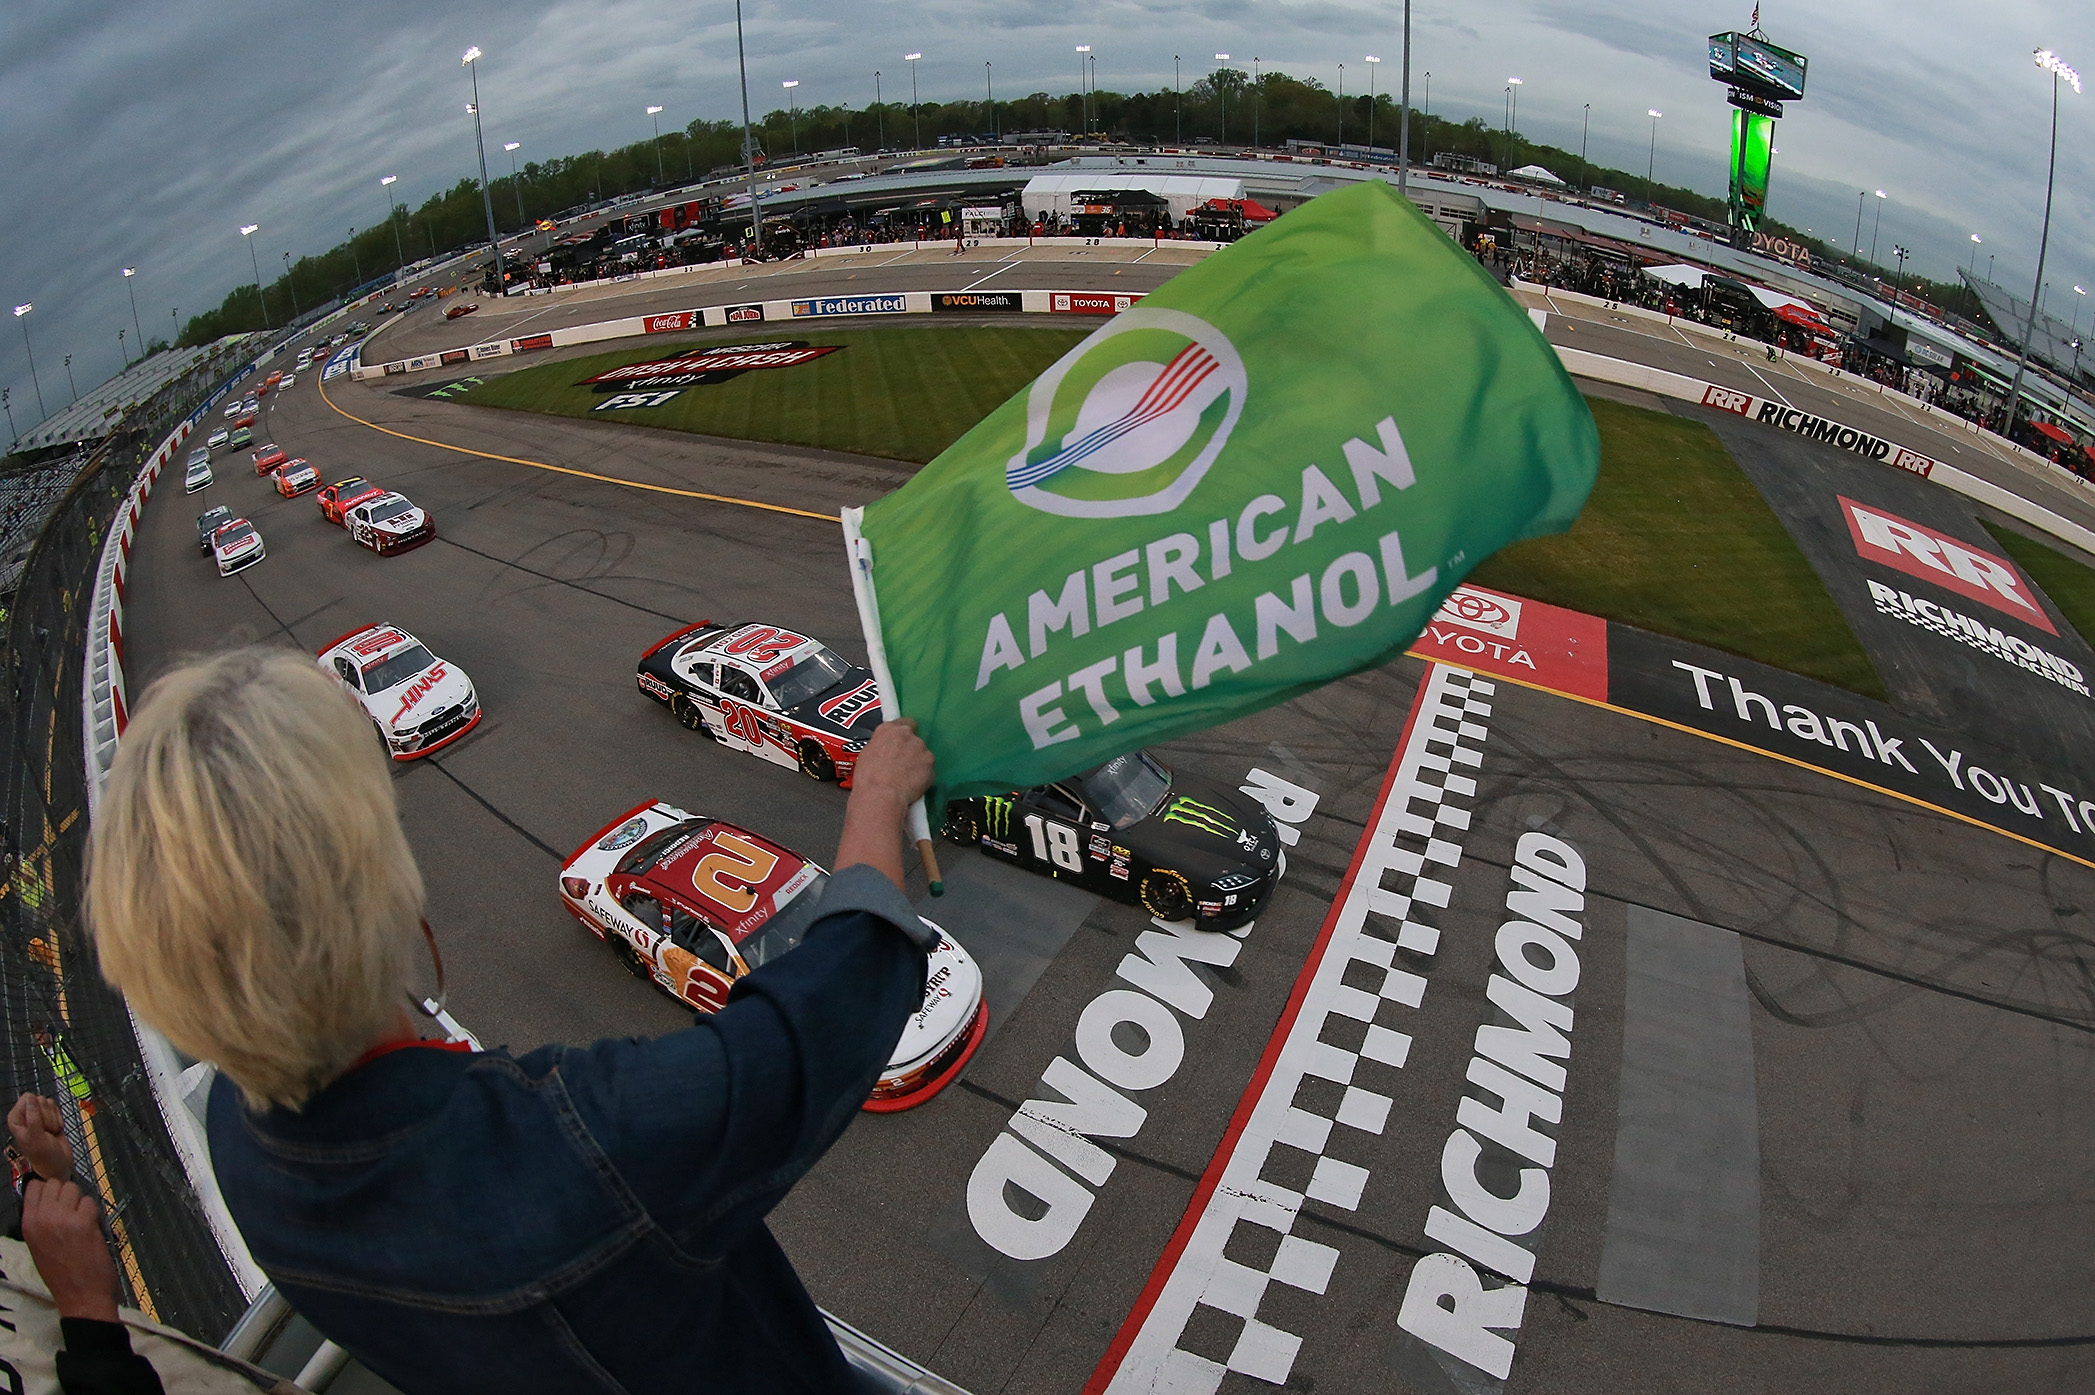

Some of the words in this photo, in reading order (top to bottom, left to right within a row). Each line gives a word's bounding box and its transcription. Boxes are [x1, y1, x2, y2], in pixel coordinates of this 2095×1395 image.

[1739, 92, 1754, 102] ISM
[859, 245, 872, 253] 30
[966, 239, 979, 247] 29
[1085, 238, 1100, 246] 28
[1752, 231, 1811, 265] OYOTA
[815, 296, 905, 314] Federated
[1073, 299, 1110, 308] TOYOTA
[1603, 301, 1618, 310] 25
[1722, 333, 1737, 342] 24
[597, 360, 689, 380] DASH
[683, 357, 720, 371] 4
[706, 350, 816, 369] CASH
[1828, 367, 1841, 377] 23
[624, 373, 707, 390] xfinity
[595, 390, 681, 411] FS1
[1705, 389, 1748, 413] RR
[1756, 401, 1891, 462] RICHMOND
[1896, 450, 1930, 475] RR
[328, 503, 334, 518] 7
[974, 415, 1417, 692] AMERICAN
[1850, 505, 2038, 613] RR
[1019, 530, 1438, 750] ETHANOL
[1866, 578, 2084, 683] RICHMOND
[724, 628, 809, 664] 20
[1418, 626, 1537, 670] YOTA
[365, 657, 384, 670] xfinity
[765, 661, 790, 678] xfinity
[2001, 652, 2091, 698] RACEWAY
[719, 698, 764, 748] 20
[1671, 659, 1920, 775] Thank
[1918, 737, 2044, 819] You
[1106, 754, 1127, 776] xfinity
[1023, 812, 1083, 874] 18
[692, 830, 780, 914] 2
[784, 873, 810, 896] REDDICK
[1224, 894, 1238, 906] 18
[587, 899, 634, 940] SAFEWAY
[735, 906, 769, 935] xfinity
[683, 966, 733, 1015] 2
[914, 993, 942, 1024] SAFEWAY
[966, 767, 1320, 1261] RMOND
[890, 1077, 905, 1087] 2
[1398, 831, 1587, 1380] RICHMOND
